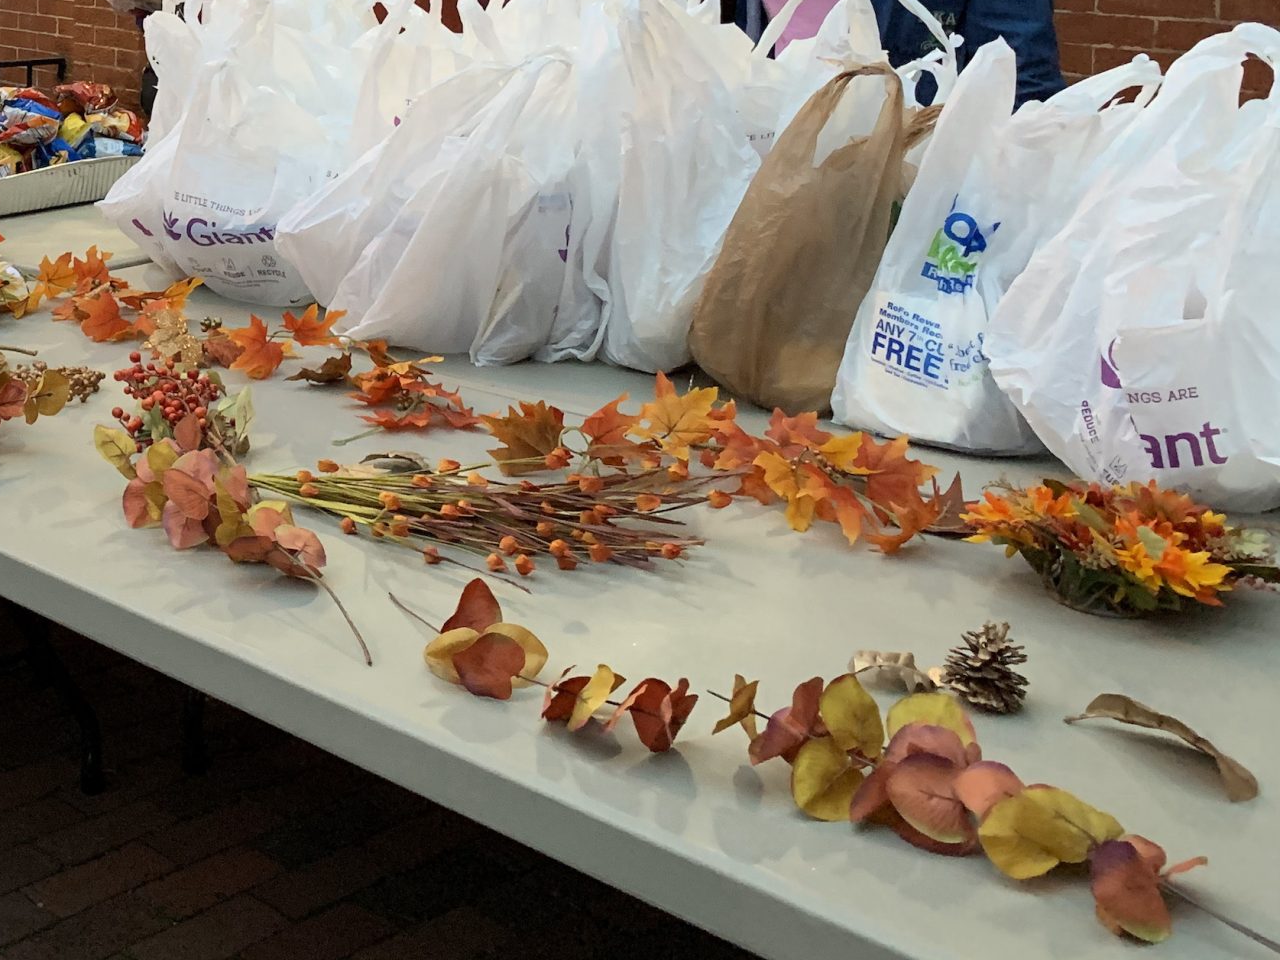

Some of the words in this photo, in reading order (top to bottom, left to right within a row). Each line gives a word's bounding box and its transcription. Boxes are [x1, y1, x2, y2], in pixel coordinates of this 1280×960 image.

[181, 193, 208, 208] LITTLE
[210, 200, 246, 216] THINGS
[186, 217, 274, 247] Giant
[876, 318, 905, 339] ANY
[879, 308, 919, 331] Members
[912, 313, 941, 329] Rewa
[1128, 392, 1162, 404] NGS
[1167, 387, 1199, 402] ARE
[1139, 421, 1229, 469] ant
